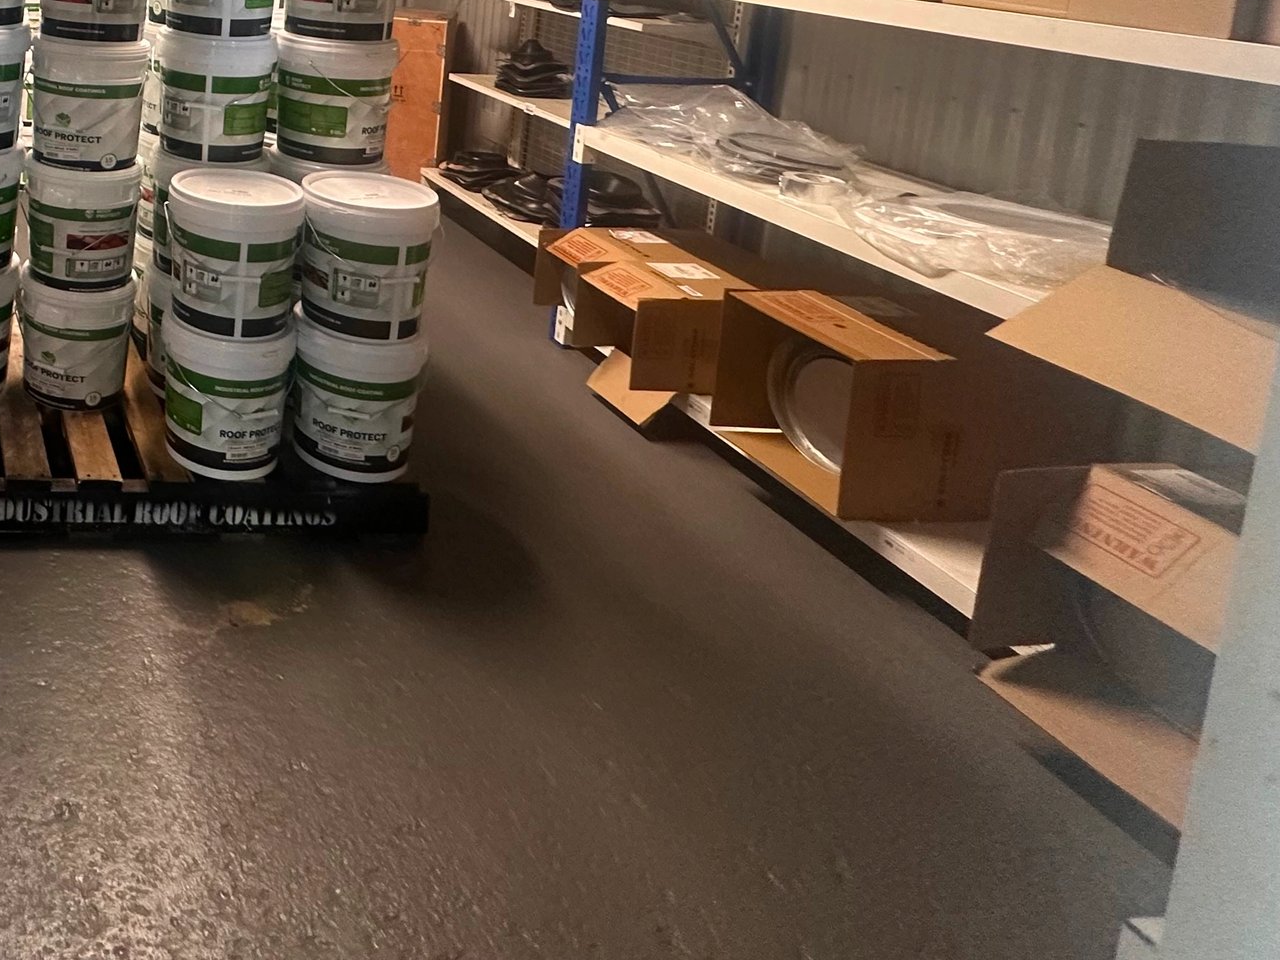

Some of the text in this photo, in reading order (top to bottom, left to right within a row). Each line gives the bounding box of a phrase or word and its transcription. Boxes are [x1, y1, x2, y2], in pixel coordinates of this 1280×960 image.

[55, 131, 102, 144] PROTECT
[362, 126, 380, 135] ROOF
[41, 368, 87, 383] PROTECT
[220, 429, 247, 439] ROOF
[312, 418, 388, 441] ROOF PROTECT
[134, 501, 201, 526] ROOF
[208, 505, 337, 528] COATINGS
